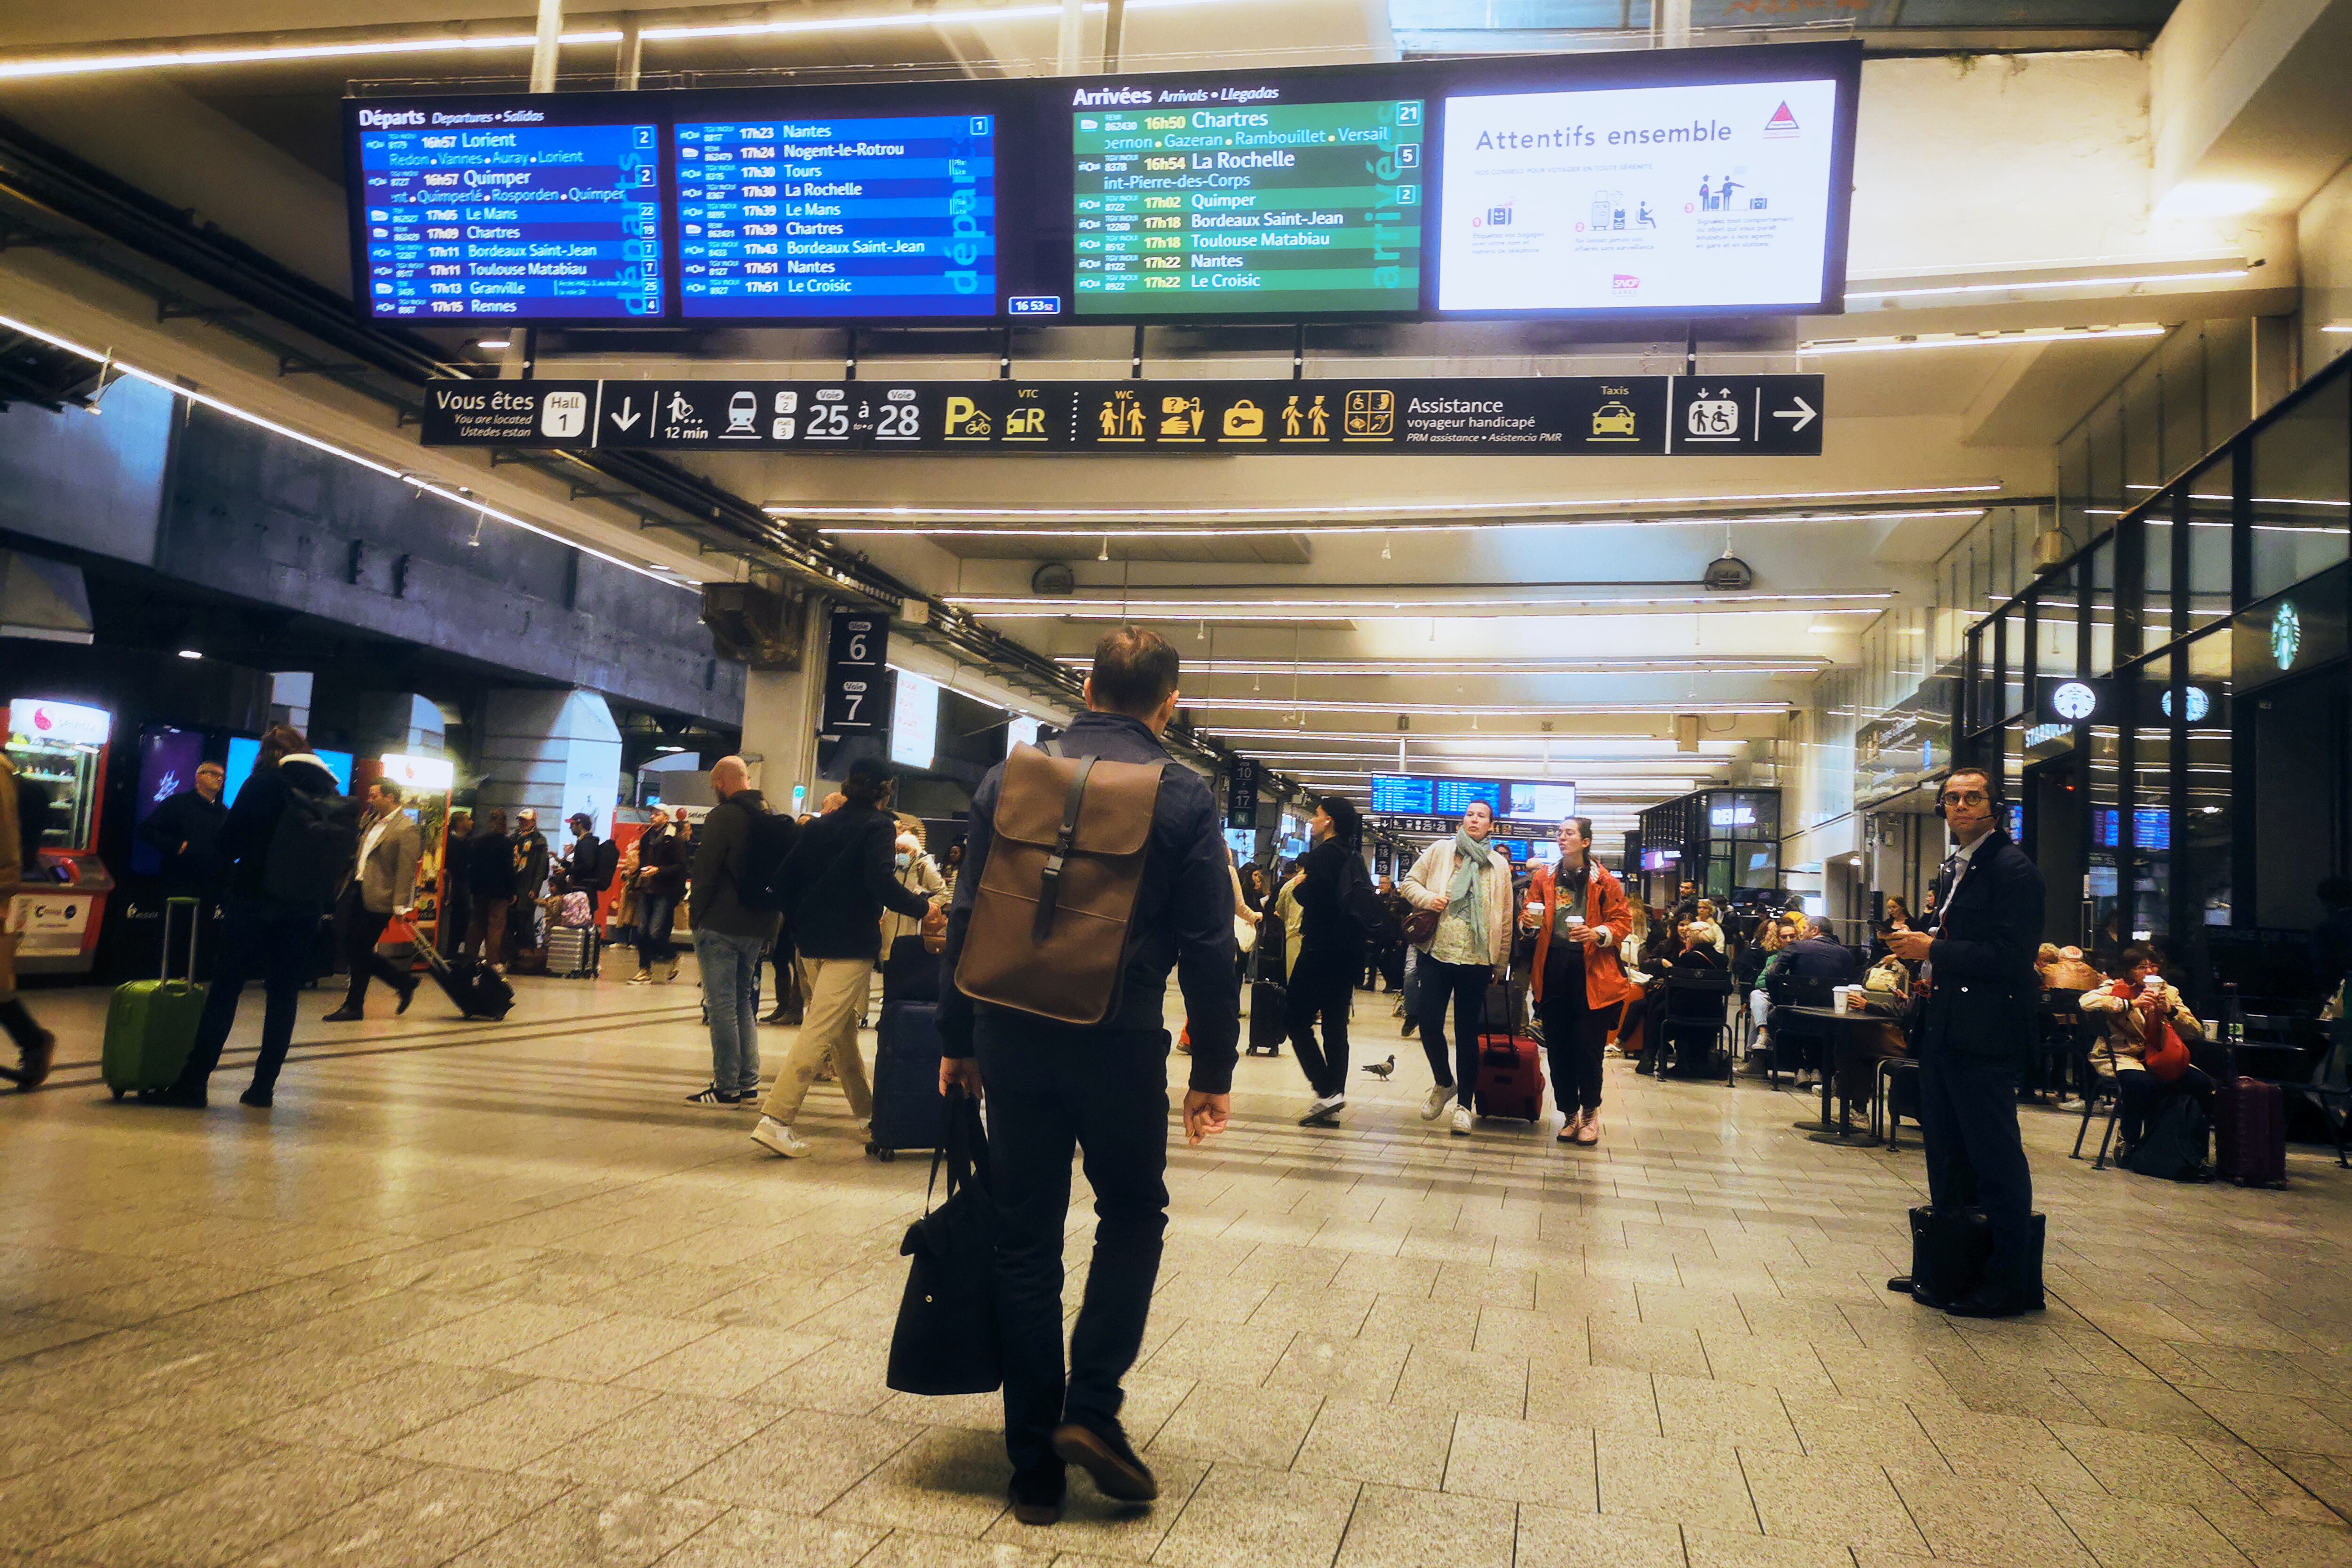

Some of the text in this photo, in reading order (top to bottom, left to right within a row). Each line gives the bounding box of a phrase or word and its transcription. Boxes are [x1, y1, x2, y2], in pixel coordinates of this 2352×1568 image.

[1073, 87, 1279, 105] Arrivées Arrivals Llegadas
[359, 110, 545, 129] Départs Departures Salidas
[1144, 116, 1186, 130] 16h50
[1192, 111, 1268, 128] Chartres
[1400, 107, 1417, 120] 21
[739, 127, 774, 139] 17h23
[783, 125, 832, 138] Nantes
[976, 121, 982, 130] 1
[1475, 119, 1732, 151] Attentifs ensemble
[421, 136, 457, 148] 16h57
[462, 132, 517, 148] Lorient
[640, 131, 649, 143] 2
[1164, 134, 1223, 147] Gazeran
[1235, 129, 1326, 145] Rambouillet
[740, 147, 775, 158] 17h24
[784, 143, 904, 160] Nogent-le-Rotrou
[389, 151, 584, 167] Redon Vannes Auray Lorient
[1144, 157, 1186, 171] 16h54
[1192, 153, 1212, 169] La
[1218, 151, 1295, 168] Rochelle
[1403, 149, 1413, 162] 5
[741, 167, 776, 177] 17h30
[784, 165, 822, 177] Tours
[423, 173, 460, 186] 16h57
[464, 170, 532, 188] Quimper
[642, 169, 651, 182] 2
[417, 189, 483, 205] Quimperlé
[492, 188, 559, 204] Rosporden
[568, 187, 625, 203] Quimper
[742, 186, 776, 197] 17h30
[785, 184, 801, 196] La
[804, 183, 863, 196] Rochelle
[1144, 197, 1181, 208] 17h02
[1192, 194, 1256, 210] Quimper
[1402, 190, 1410, 199] 2
[466, 208, 482, 220] Le
[484, 207, 518, 220] Mans
[641, 207, 654, 216] 22
[743, 205, 777, 216] 17h39
[786, 203, 802, 216] Le
[805, 203, 841, 216] Mans
[1144, 217, 1181, 228] 17h18
[1192, 214, 1260, 228] Bordeaux
[1263, 211, 1343, 226] Saint-Jean
[467, 226, 520, 239] Chartres
[743, 224, 778, 235] 17h39
[786, 222, 843, 235] Chartres
[744, 243, 778, 255] 17h43
[787, 241, 849, 255] Bordeaux
[852, 239, 925, 254] Saint-Jean
[1144, 237, 1181, 248] 17h18
[1191, 234, 1257, 247] Toulouse
[1261, 232, 1330, 246] Matabiau
[428, 246, 459, 257] 17h11
[468, 244, 527, 257] Bordeaux
[529, 243, 597, 256] Saint-Jean
[645, 244, 652, 253] 7
[744, 263, 778, 273] 17h51
[787, 260, 835, 273] Nantes
[1144, 256, 1181, 268] 17h22
[1191, 254, 1243, 268] Nantes
[429, 264, 461, 276] 17h11
[468, 263, 526, 275] Toulouse
[528, 262, 587, 275] Matabiau
[646, 263, 653, 271] 7
[470, 281, 526, 294] Granville
[745, 281, 779, 292] 17h51
[788, 279, 804, 292] Le
[807, 279, 852, 292] Croisic
[1144, 277, 1181, 288] 17h22
[1192, 274, 1208, 287] Le
[1211, 273, 1261, 287] Croisic
[471, 299, 517, 312] Rennes
[648, 301, 655, 309] 4
[1017, 389, 1039, 398] VTC
[1115, 390, 1134, 400] WC
[1601, 386, 1629, 396] Taxis
[436, 390, 534, 410] Vous êtes
[551, 397, 579, 409] Hall
[782, 402, 789, 411] 2
[1408, 398, 1503, 414] Assistance
[455, 414, 473, 424] You
[806, 400, 920, 436] 25 à 28
[945, 396, 975, 435] P
[558, 414, 568, 432] 1
[1407, 416, 1536, 430] voyageur handicapé
[665, 427, 708, 439] 12 min
[780, 428, 787, 437] 3
[1406, 433, 1562, 442] PRM assistance Asistencia PMR
[850, 634, 866, 661] 6
[845, 694, 863, 721] 7
[1238, 767, 1252, 779] 10
[1235, 796, 1250, 807] 17
